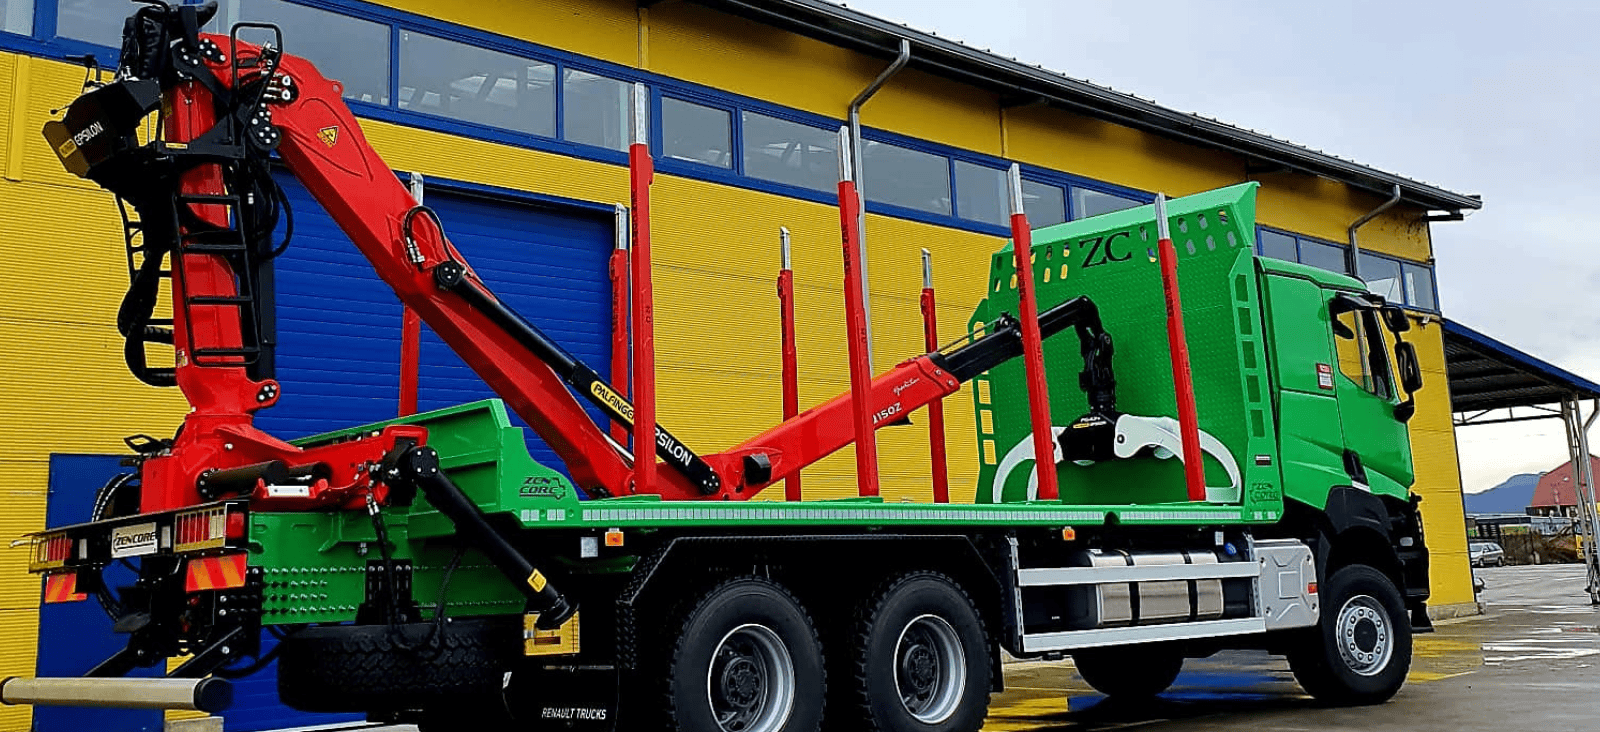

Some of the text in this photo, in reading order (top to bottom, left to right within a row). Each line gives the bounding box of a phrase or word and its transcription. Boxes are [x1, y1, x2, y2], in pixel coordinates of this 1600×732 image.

[74, 121, 104, 146] EPSILON
[1079, 231, 1132, 268] ZC
[593, 383, 635, 420] PALFINGE
[541, 706, 607, 720] RENAULT TRUCKS
